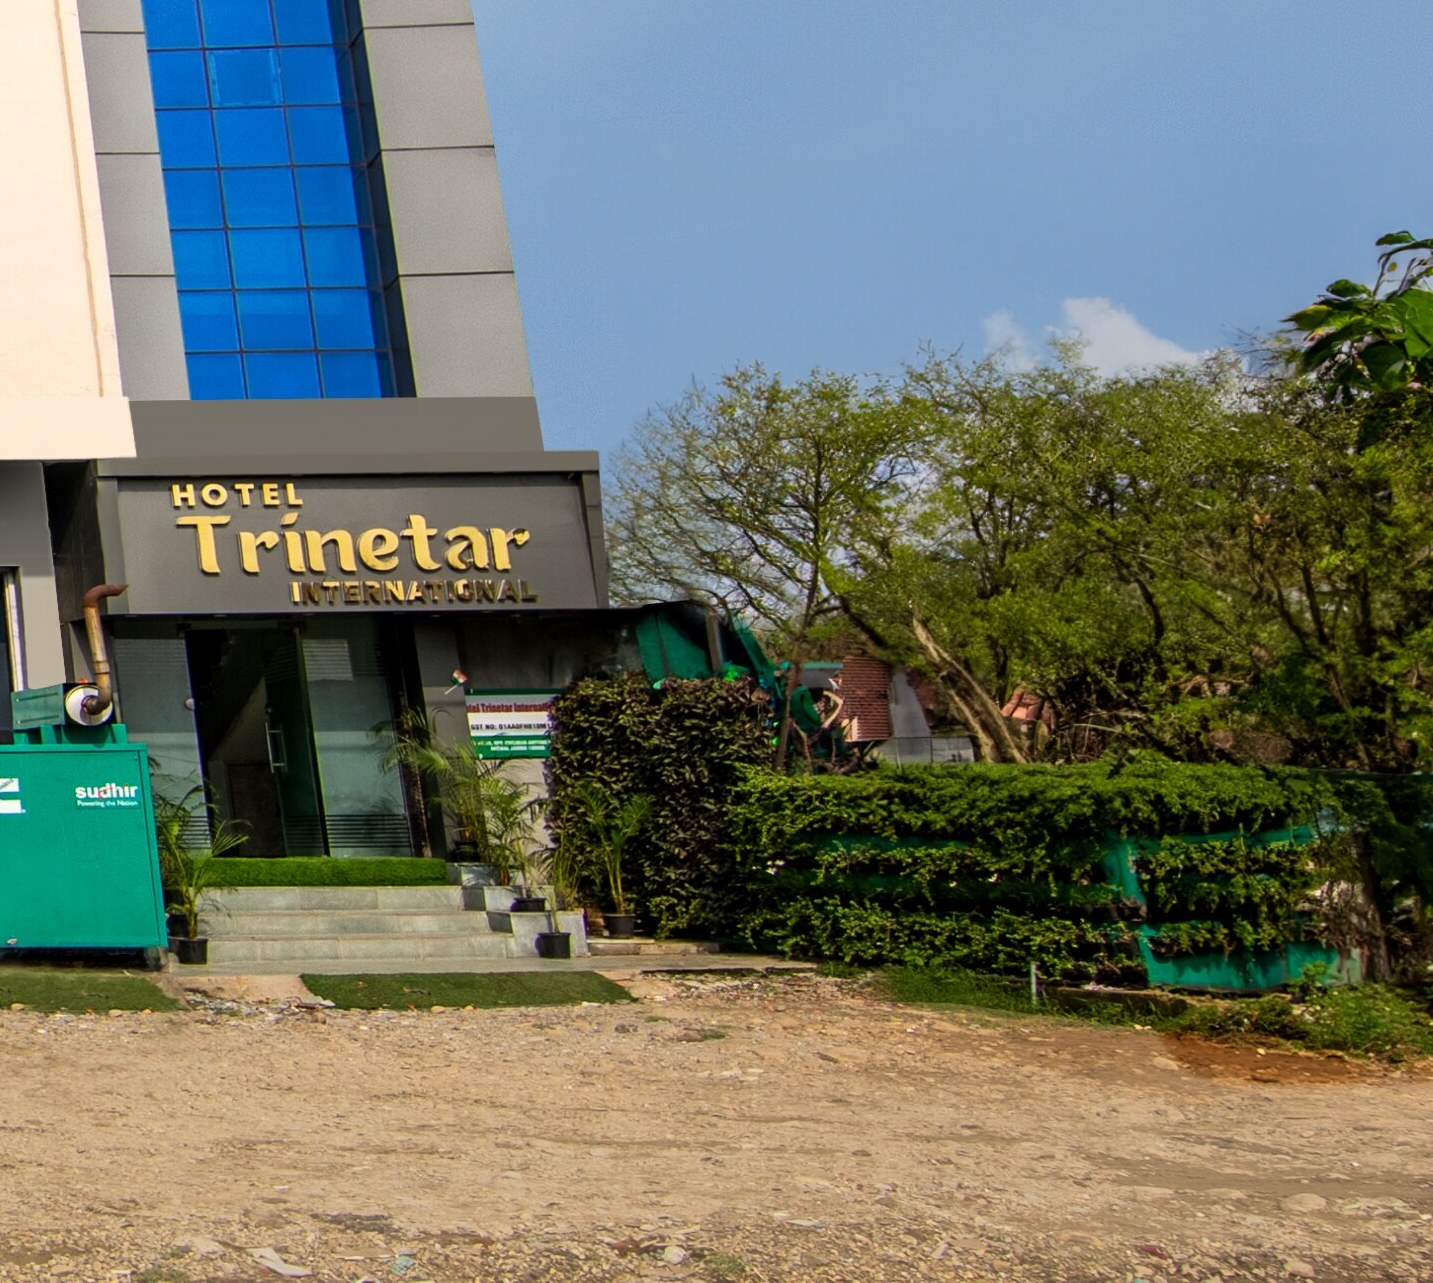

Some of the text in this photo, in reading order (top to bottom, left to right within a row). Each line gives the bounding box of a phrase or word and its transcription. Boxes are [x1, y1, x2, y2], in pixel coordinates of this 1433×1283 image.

[171, 483, 304, 508] HOTEL
[175, 512, 530, 574] Trinetar
[289, 579, 538, 604] INTERNATIONAL
[75, 782, 138, 800] sudhir
